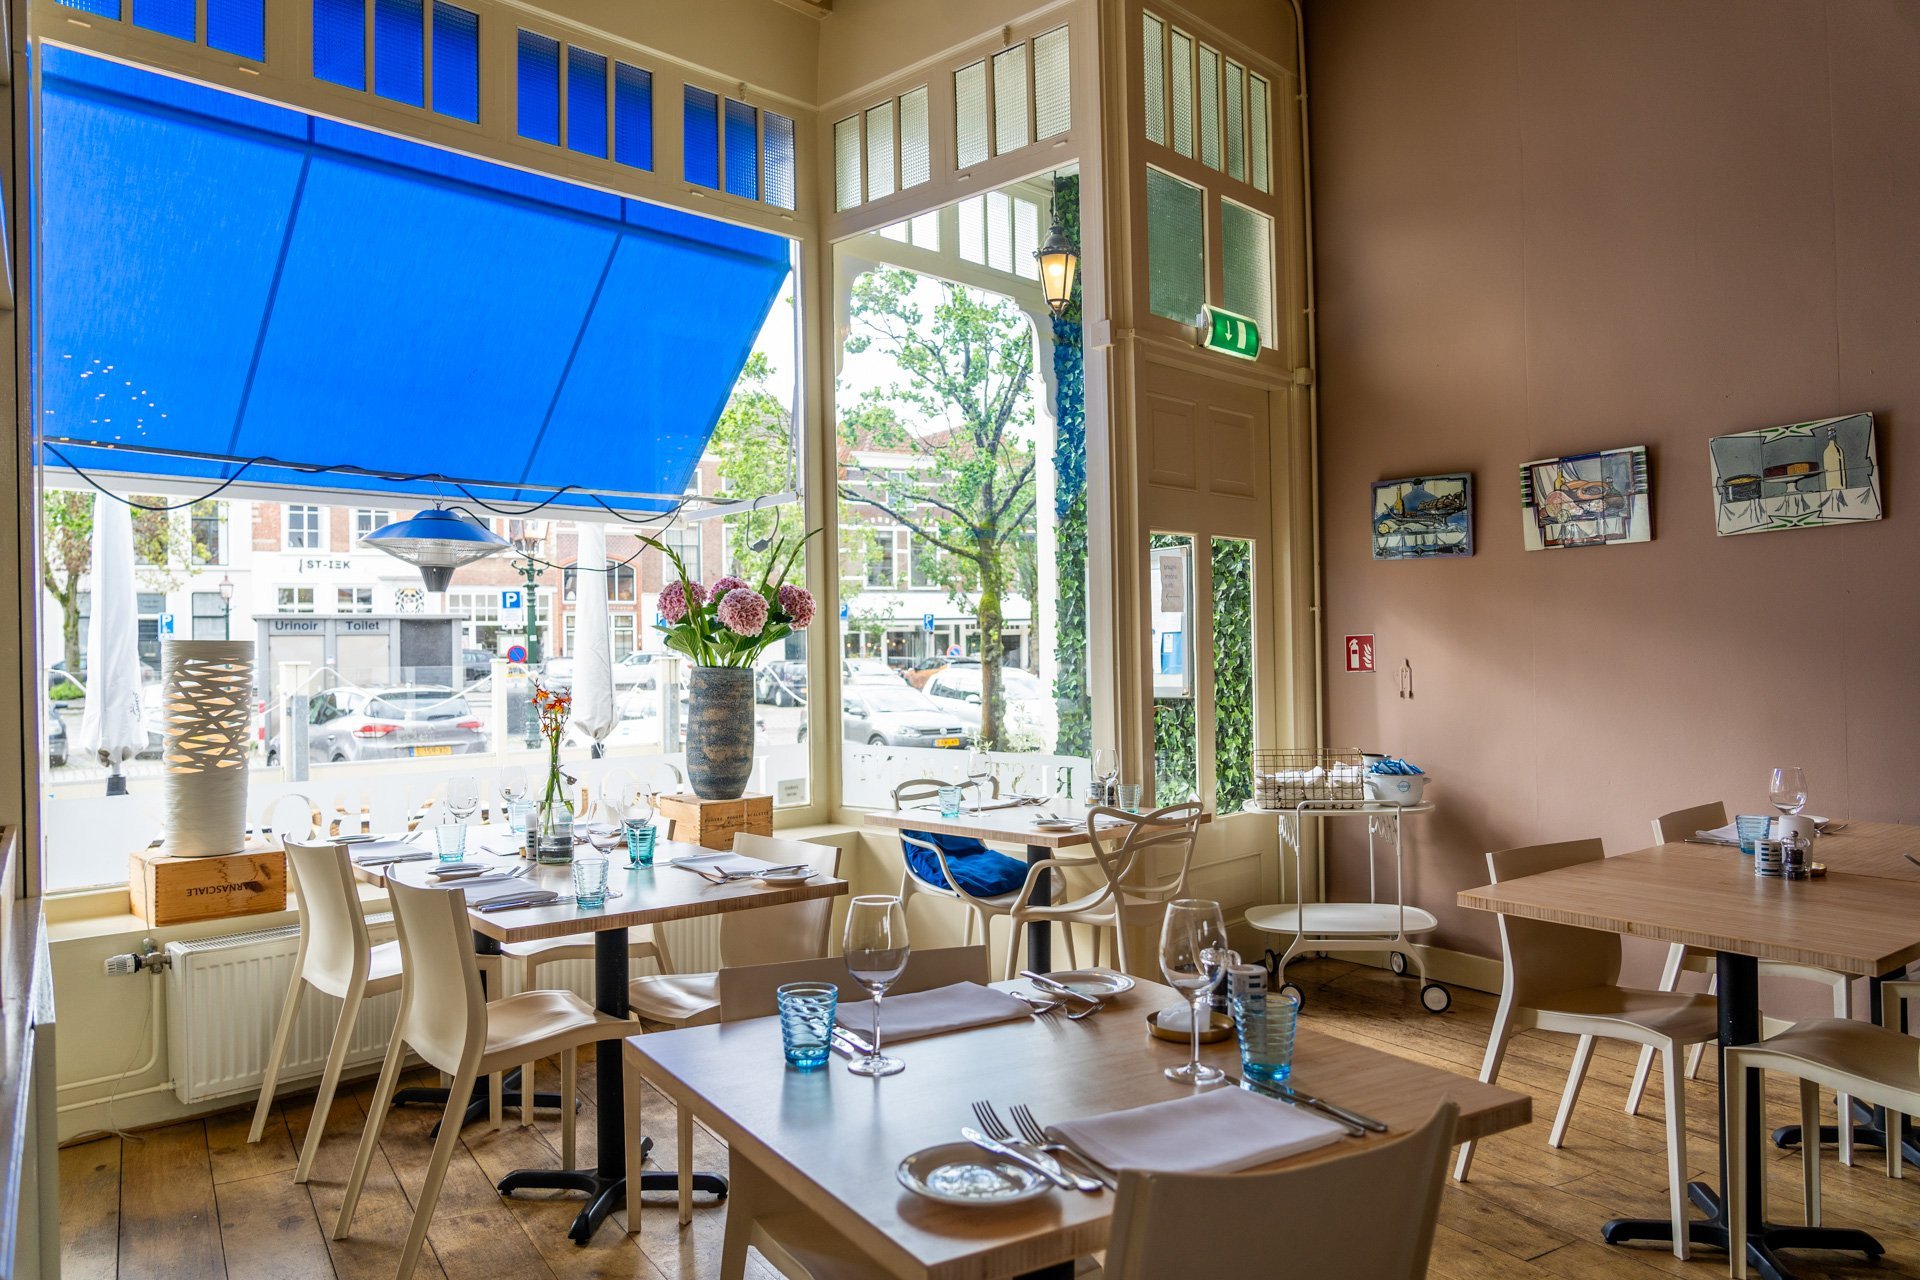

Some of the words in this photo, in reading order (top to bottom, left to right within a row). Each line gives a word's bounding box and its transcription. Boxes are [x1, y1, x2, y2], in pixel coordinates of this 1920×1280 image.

[505, 592, 517, 608] P
[275, 621, 318, 630] Urinoir
[345, 621, 379, 630] Toilet
[186, 881, 254, 897] ARNASCIALE
